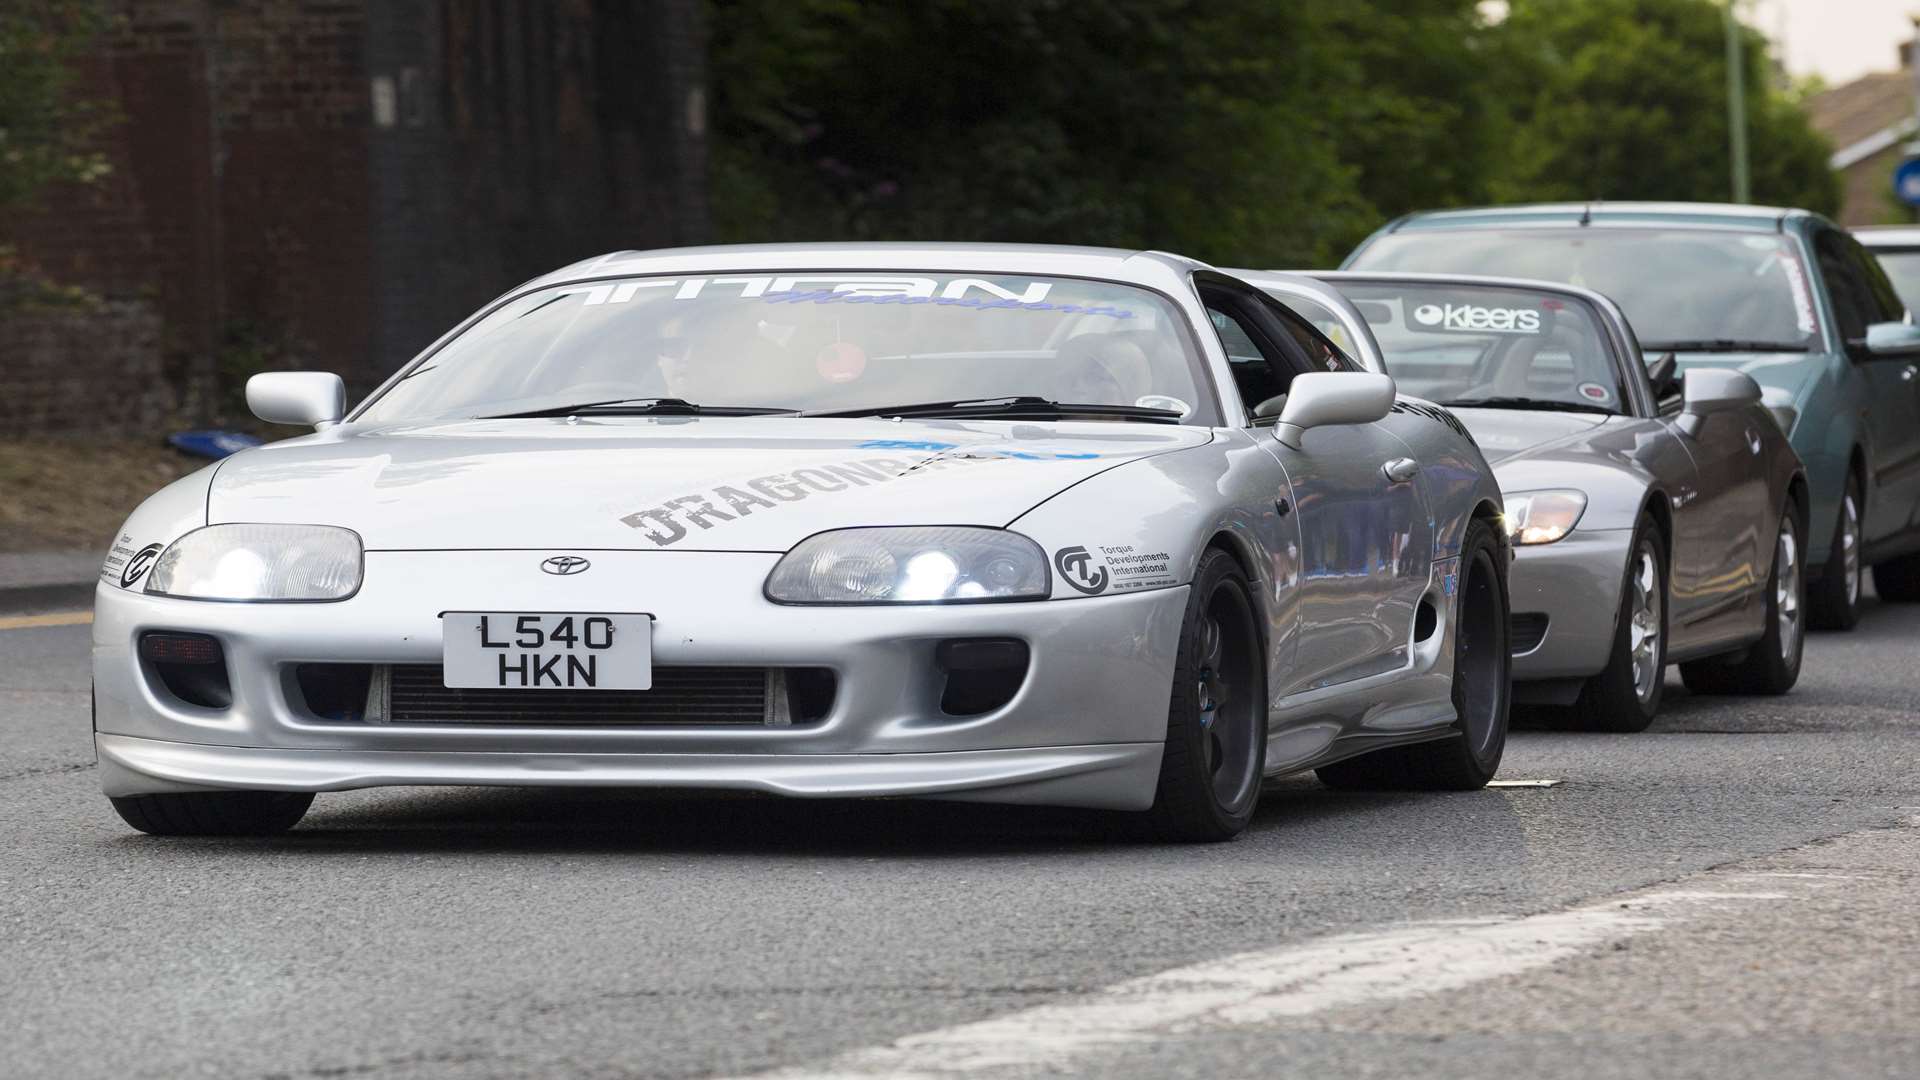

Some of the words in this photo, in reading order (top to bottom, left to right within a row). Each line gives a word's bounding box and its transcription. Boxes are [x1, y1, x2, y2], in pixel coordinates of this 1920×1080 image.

[1443, 303, 1541, 331] kleers
[1099, 544, 1134, 556] Torque
[1105, 551, 1170, 566] Developments
[1112, 562, 1168, 577] International
[480, 615, 613, 650] L540
[498, 653, 596, 688] HKN
